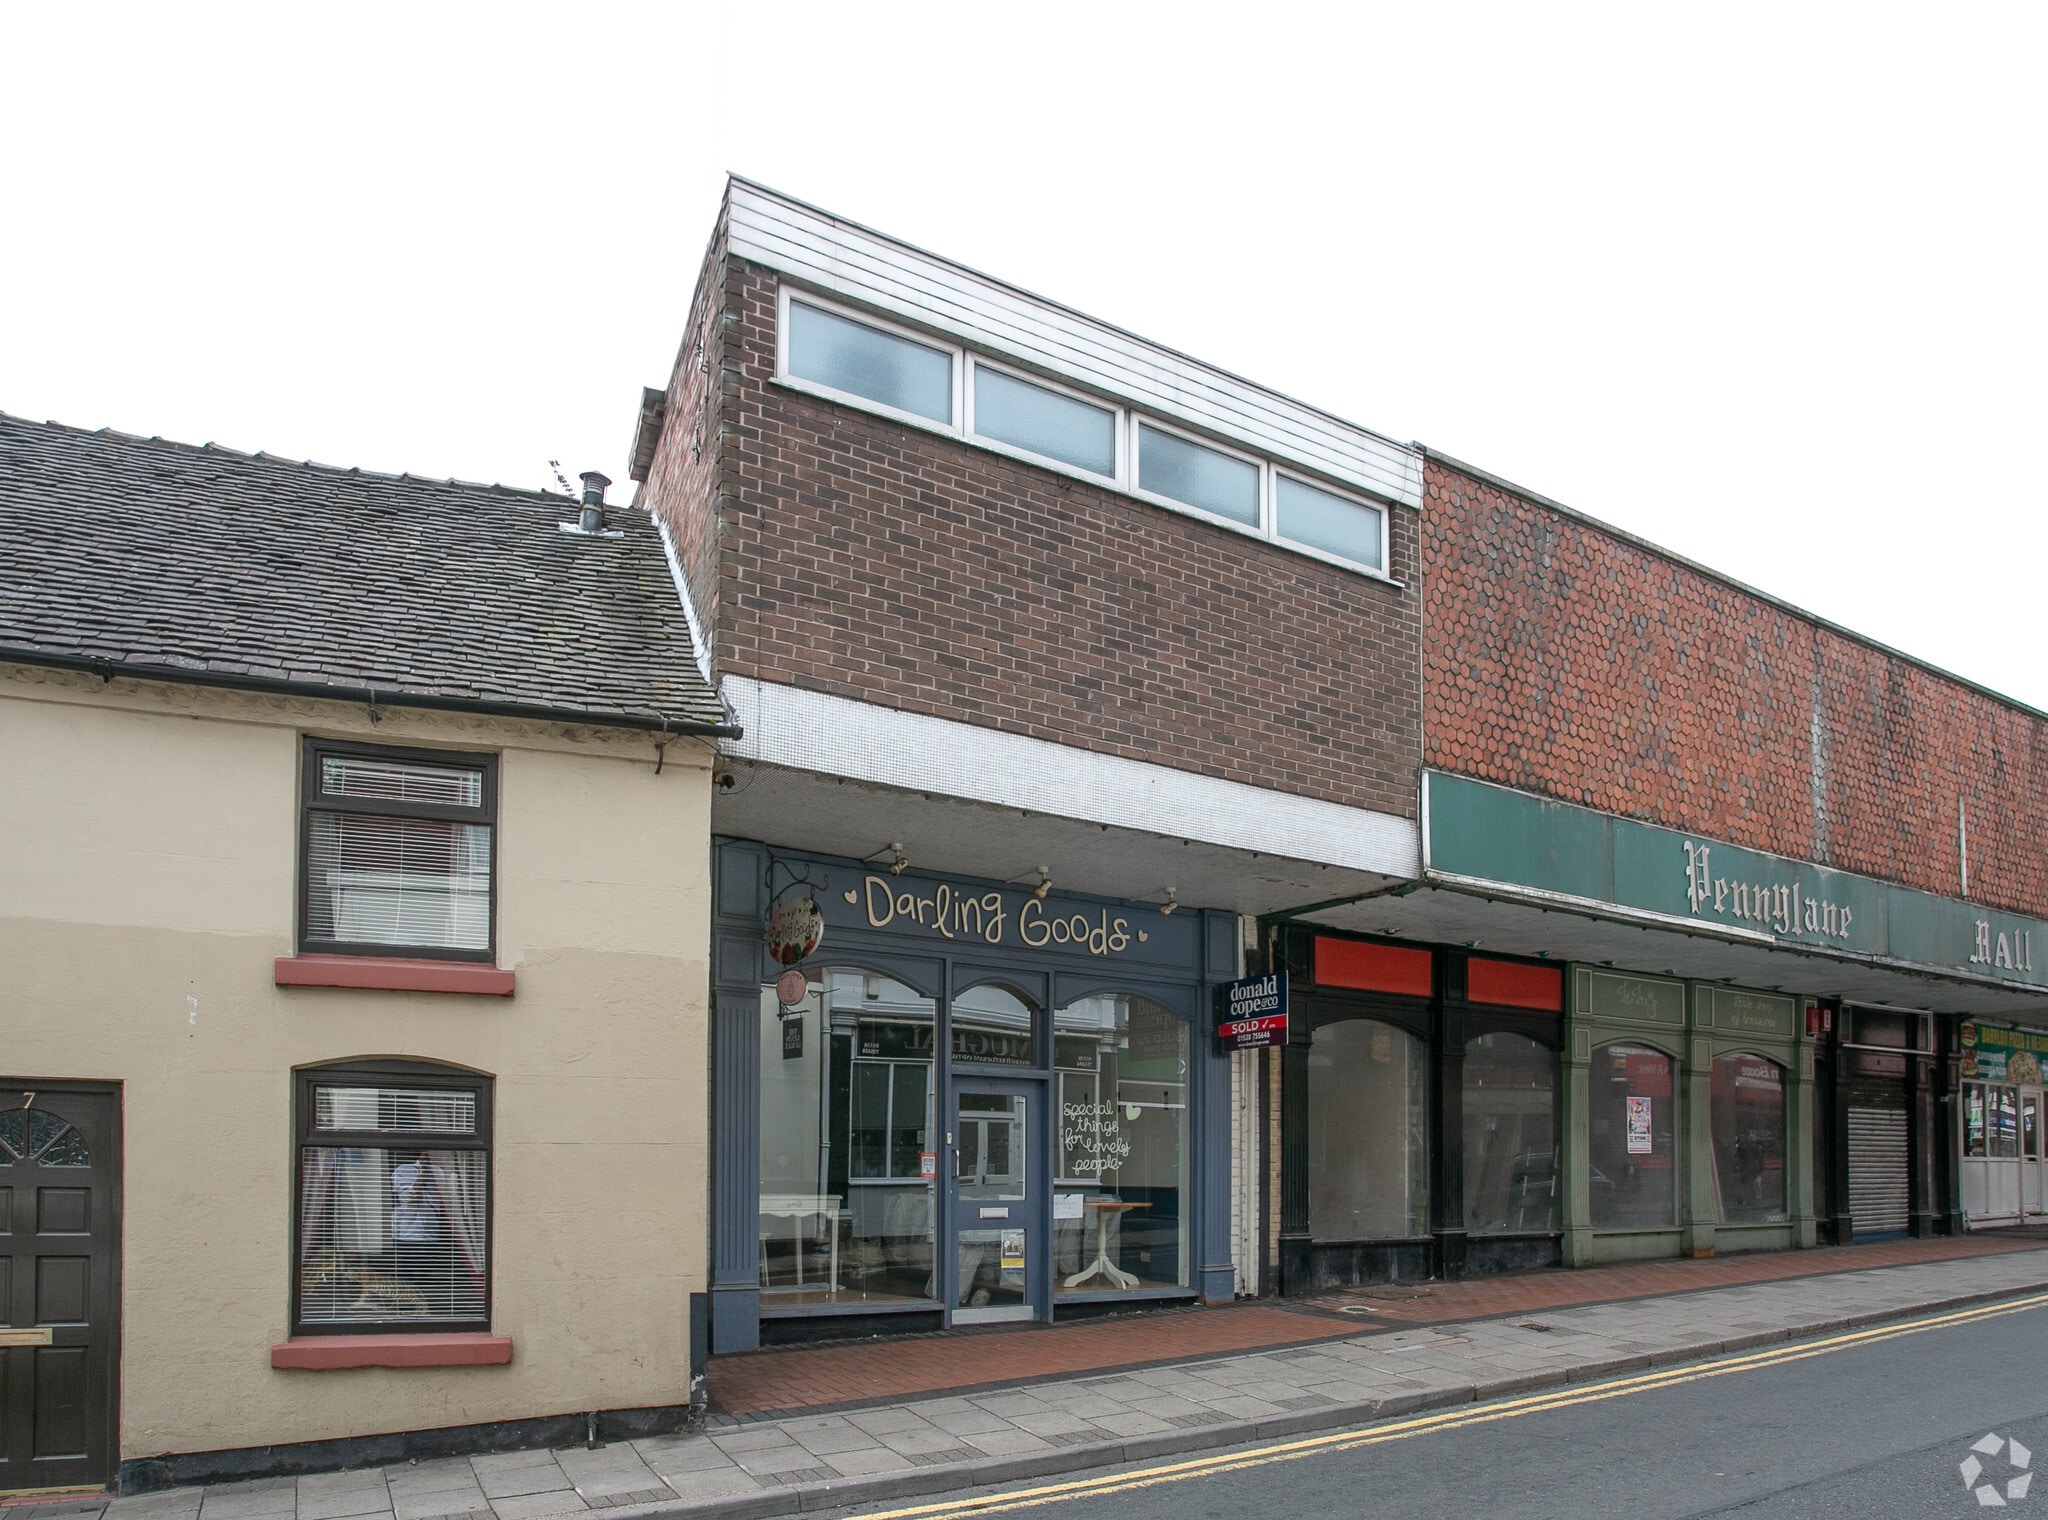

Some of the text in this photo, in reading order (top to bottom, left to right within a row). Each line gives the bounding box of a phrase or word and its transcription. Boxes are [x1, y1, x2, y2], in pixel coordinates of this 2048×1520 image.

[1683, 839, 1853, 940] Pennylane
[865, 876, 1130, 955] Darling Goods
[1230, 975, 1278, 1001] donald
[1232, 1021, 1259, 1034] SOLD
[23, 1091, 36, 1109] 7
[1063, 1099, 1113, 1121] special
[1075, 1116, 1119, 1137] things
[1065, 1127, 1131, 1157] for lovely
[1072, 1154, 1120, 1176] people
